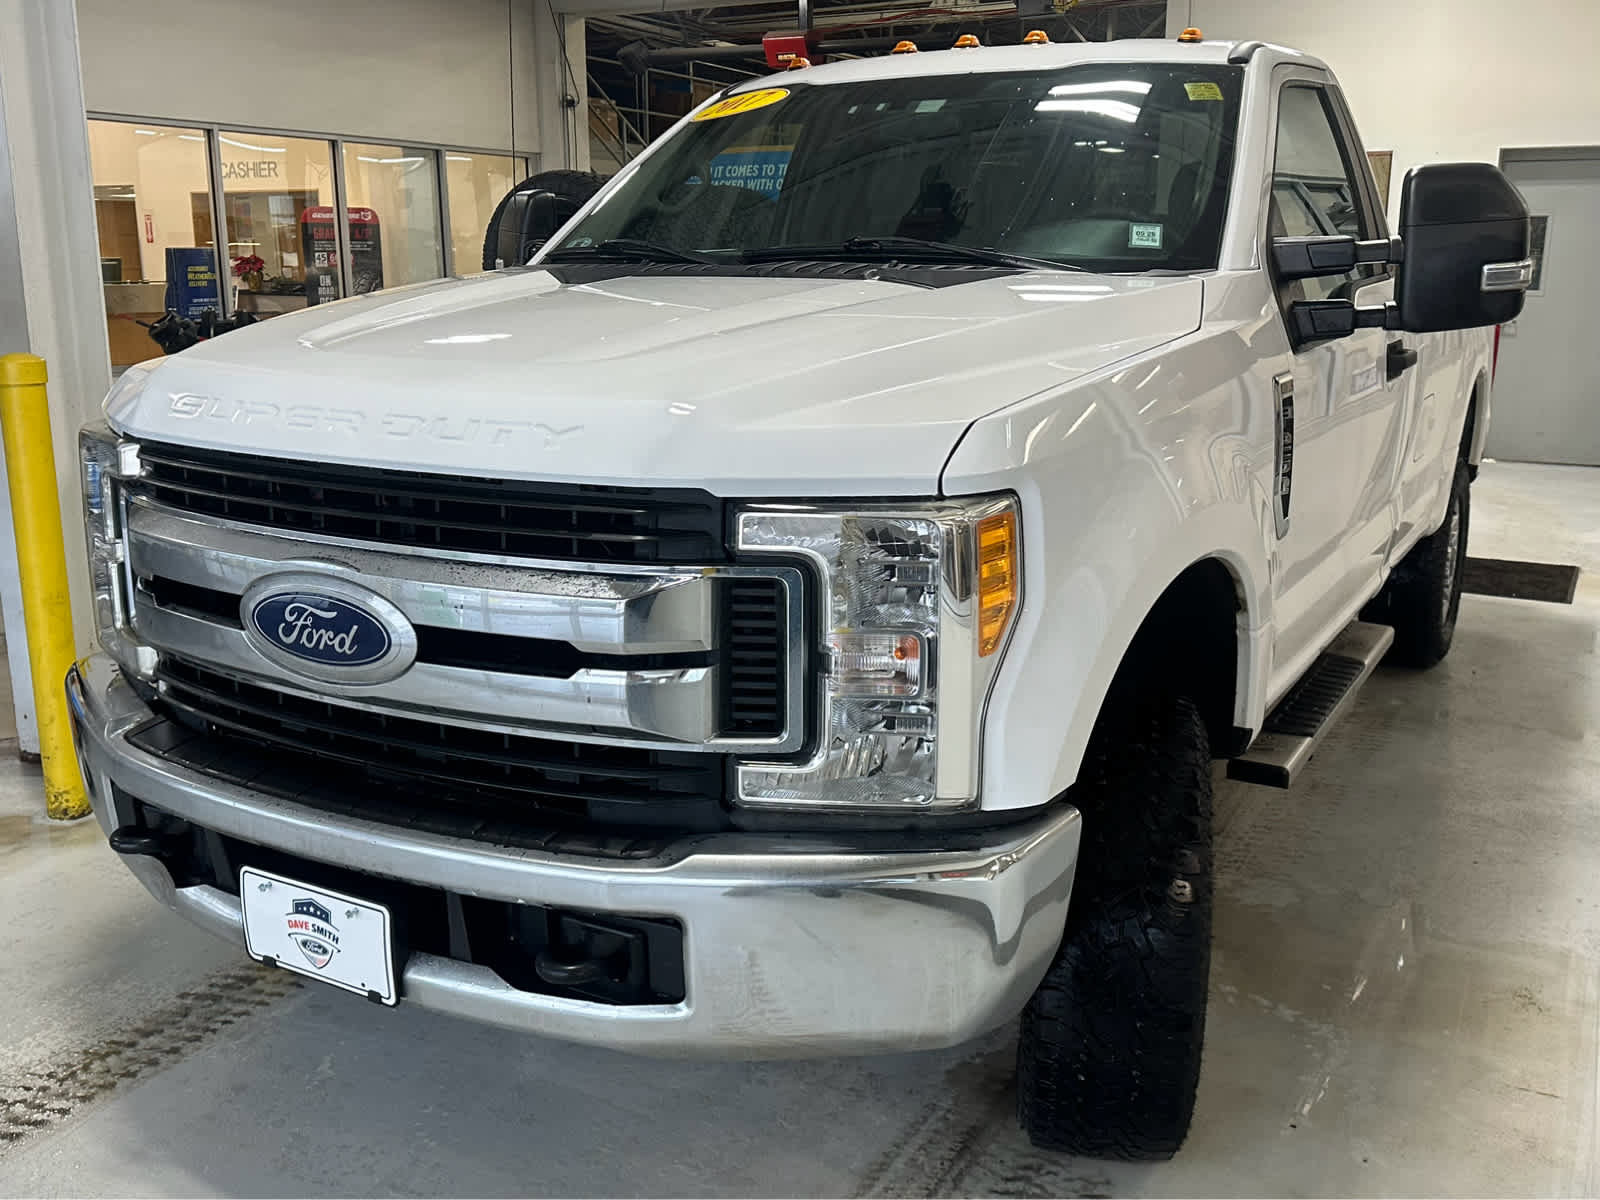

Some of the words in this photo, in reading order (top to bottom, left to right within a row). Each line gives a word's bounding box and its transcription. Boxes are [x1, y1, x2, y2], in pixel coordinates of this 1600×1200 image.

[221, 161, 279, 178] CASHIER
[714, 166, 724, 178] IT
[726, 165, 760, 177] COMES
[762, 164, 775, 177] TO
[746, 179, 774, 190] WITH
[316, 253, 327, 262] 45
[167, 391, 368, 433] SUPER
[381, 412, 585, 449] DUTY
[278, 602, 359, 655] Ford
[287, 919, 310, 931] DAVE
[311, 923, 340, 945] SMITH
